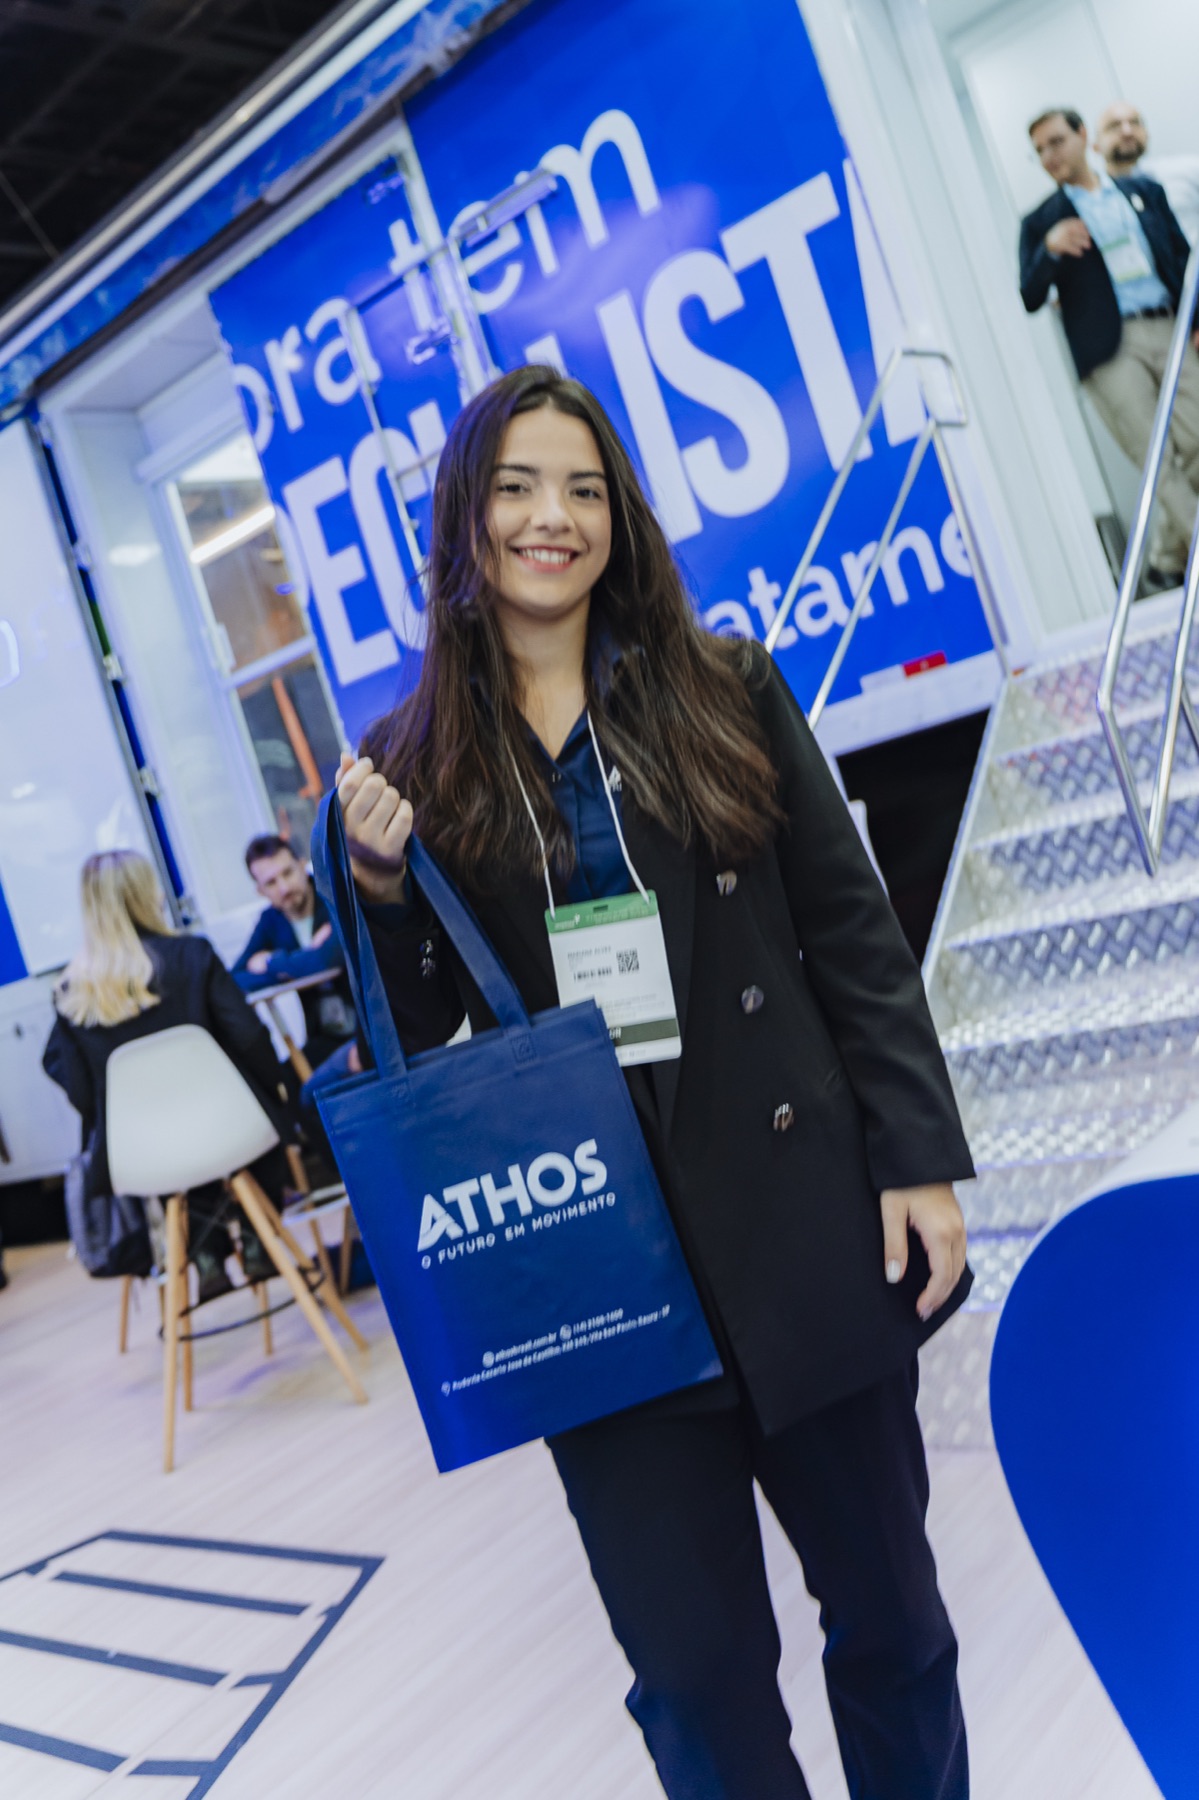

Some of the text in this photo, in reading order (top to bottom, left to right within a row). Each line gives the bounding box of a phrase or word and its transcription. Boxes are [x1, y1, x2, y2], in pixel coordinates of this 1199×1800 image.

[388, 108, 660, 335] tem
[417, 1138, 607, 1252] ATHOS
[421, 1191, 616, 1269] O FUTURO EM MOVIMENTO
